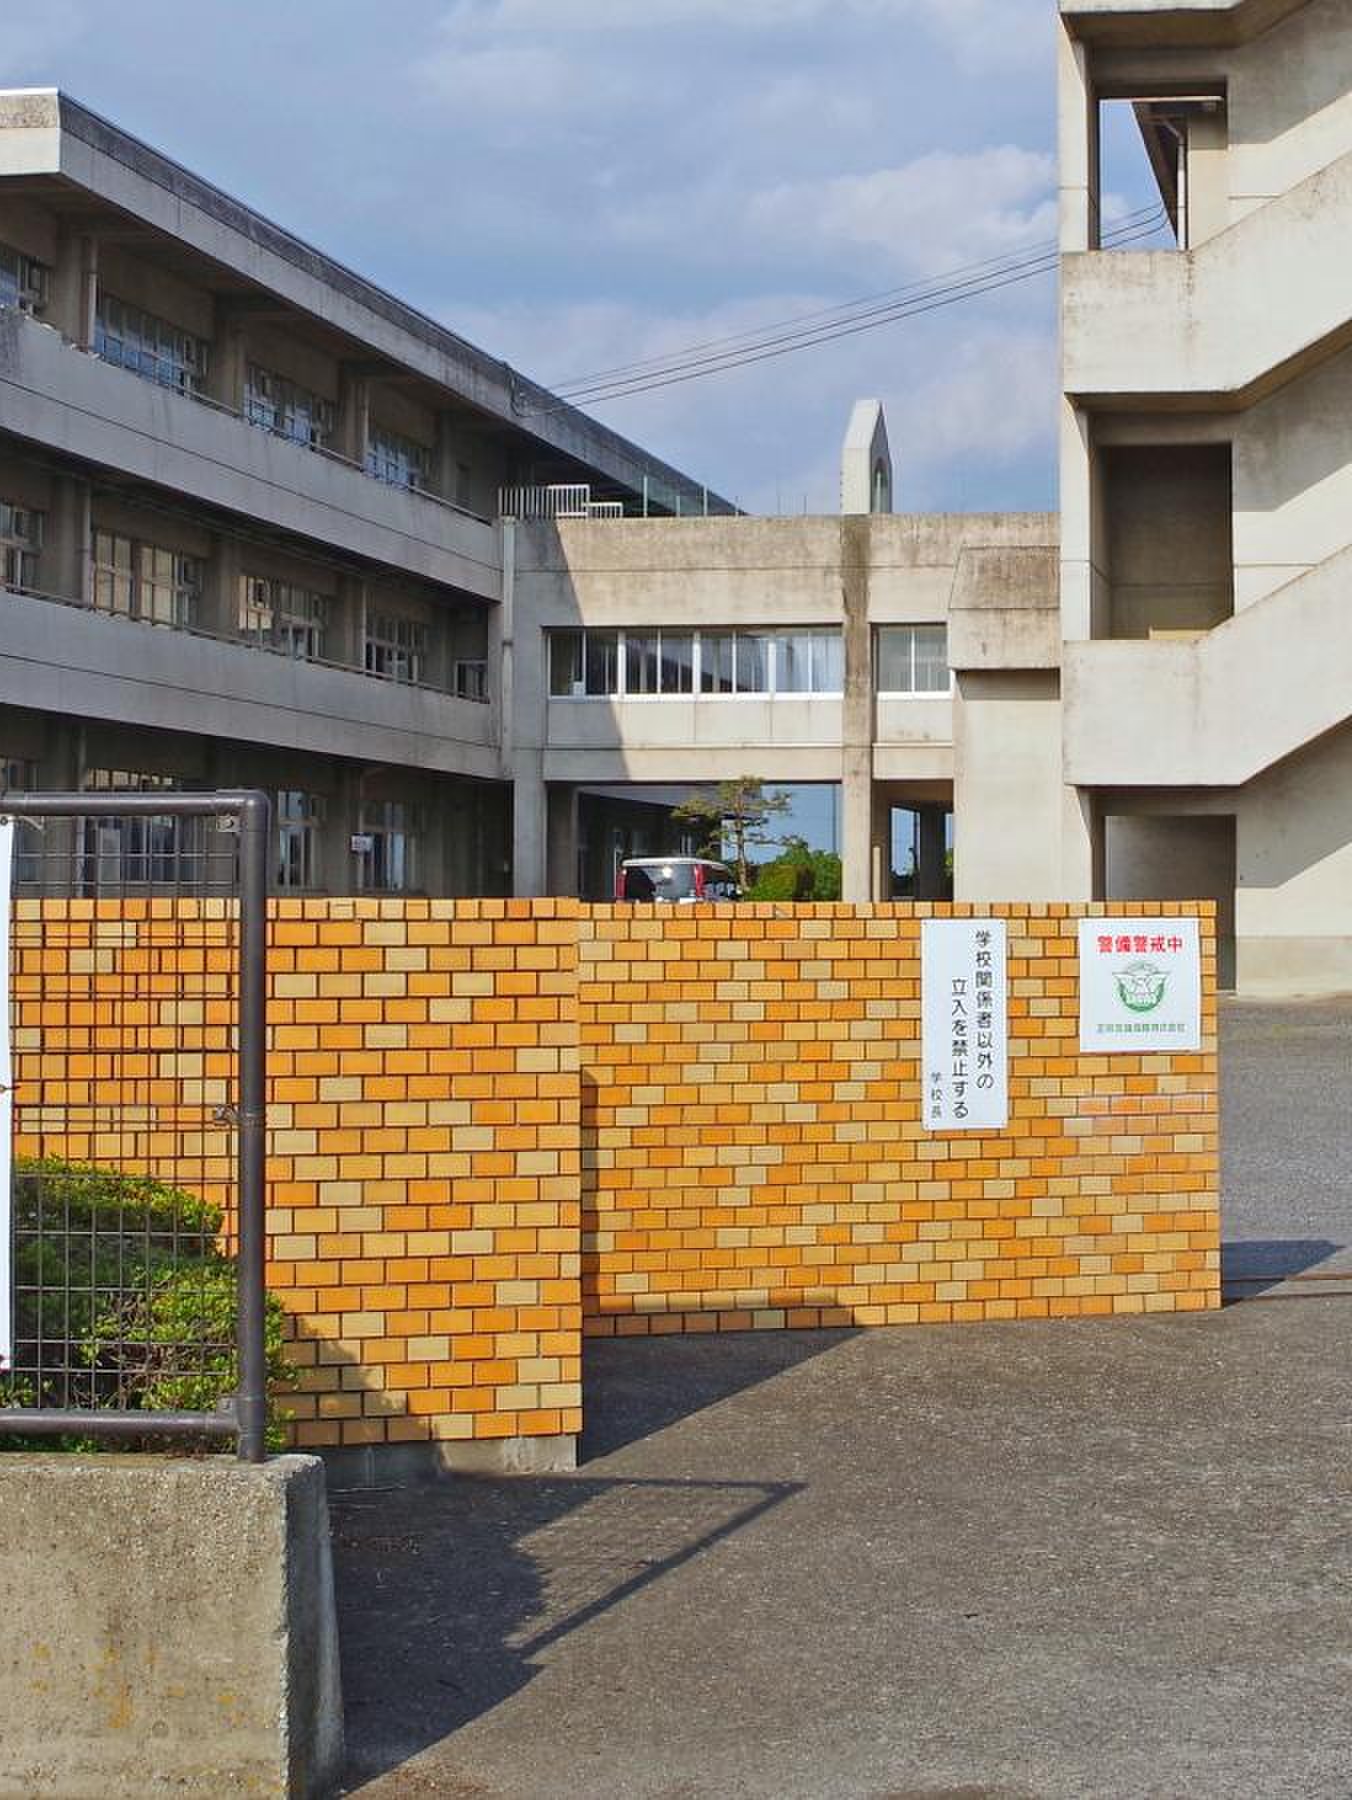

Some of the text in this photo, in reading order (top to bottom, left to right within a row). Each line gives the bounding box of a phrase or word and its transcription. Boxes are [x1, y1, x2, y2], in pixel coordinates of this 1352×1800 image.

[974, 930, 994, 1090] 学校関係者以外の
[1096, 934, 1184, 954] 警備警戒中
[951, 977, 969, 1120] 立入を禁止する
